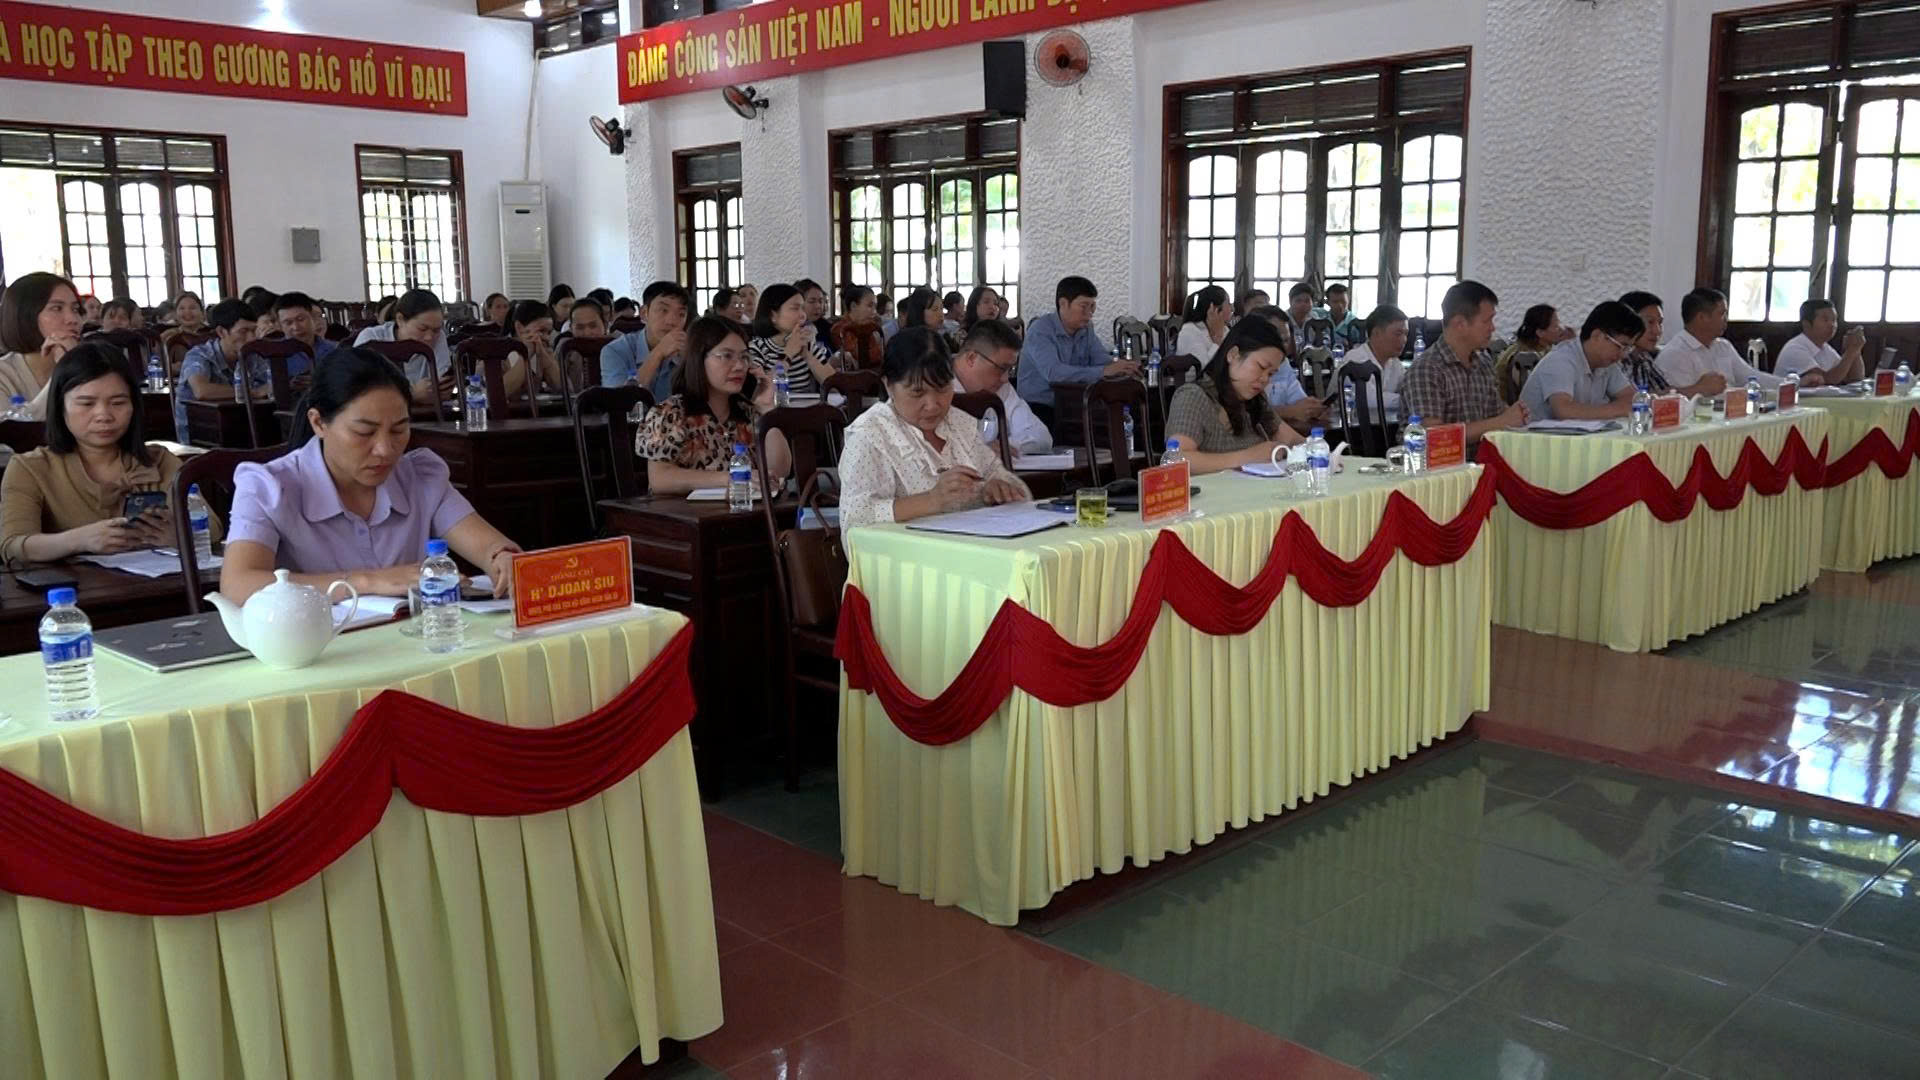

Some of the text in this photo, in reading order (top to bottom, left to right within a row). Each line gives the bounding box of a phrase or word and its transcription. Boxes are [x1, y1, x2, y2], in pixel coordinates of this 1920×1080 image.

[20, 23, 75, 76] HỌC
[84, 23, 133, 82] TẬP
[142, 36, 204, 80] THEO
[213, 42, 290, 88] GƯƠNG
[298, 47, 341, 93] BÁC
[350, 47, 377, 97] HỒ
[383, 56, 404, 98] VĨ
[411, 64, 452, 109] ĐẠI!
[627, 37, 668, 88] ĐẢNG
[674, 31, 719, 84] CỘNG
[725, 13, 762, 69] SẢN
[768, 7, 808, 66] VIỆT
[816, 1, 863, 50] NAM
[547, 579, 591, 598] DJOAN
[594, 575, 615, 590] SIU
